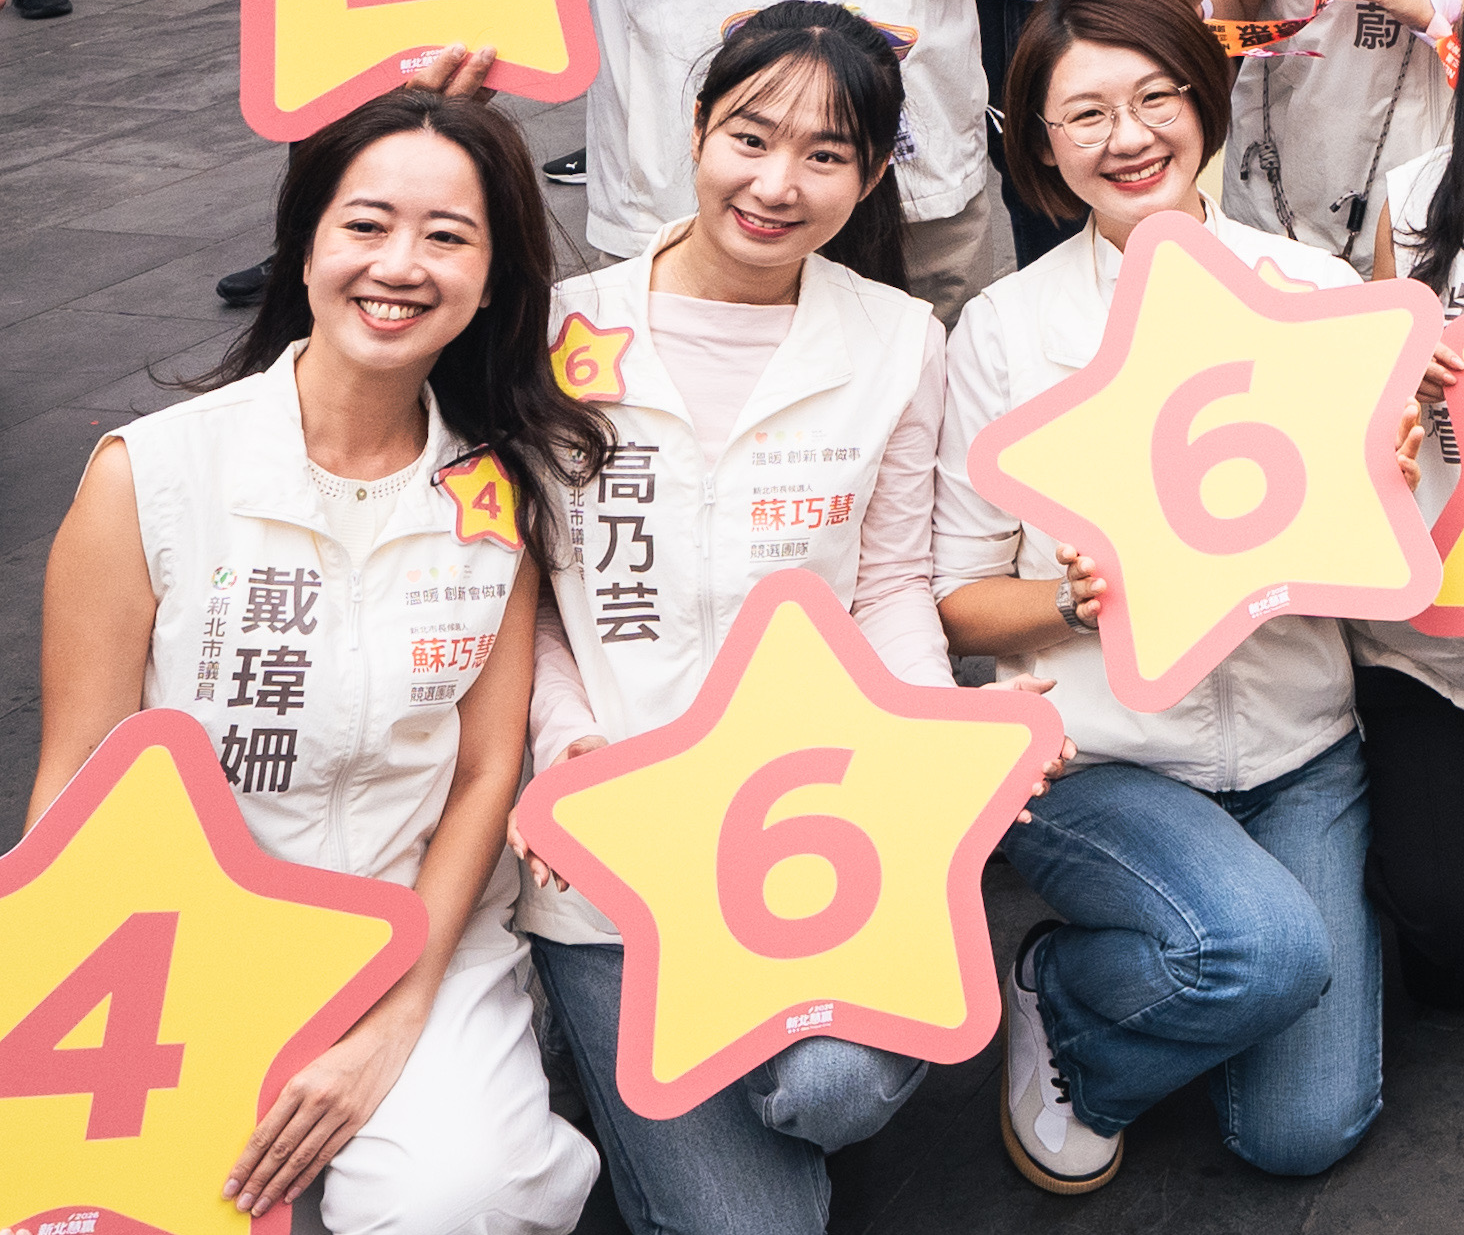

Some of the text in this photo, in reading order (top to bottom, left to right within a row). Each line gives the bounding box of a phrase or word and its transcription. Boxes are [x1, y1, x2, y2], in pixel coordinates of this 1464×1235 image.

[565, 345, 599, 387] 6
[472, 481, 502, 521] 4
[750, 492, 856, 533] 蘇巧慧
[1151, 360, 1307, 556] 6
[569, 470, 586, 582] 新北市議員
[595, 441, 661, 644] 高乃芸
[749, 542, 809, 559] 競選團隊
[194, 596, 231, 702] 新北市議員
[220, 566, 322, 794] 戴瑋姍
[411, 633, 496, 674] 蘇巧慧
[716, 746, 883, 960] 6
[0, 910, 186, 1140] 4
